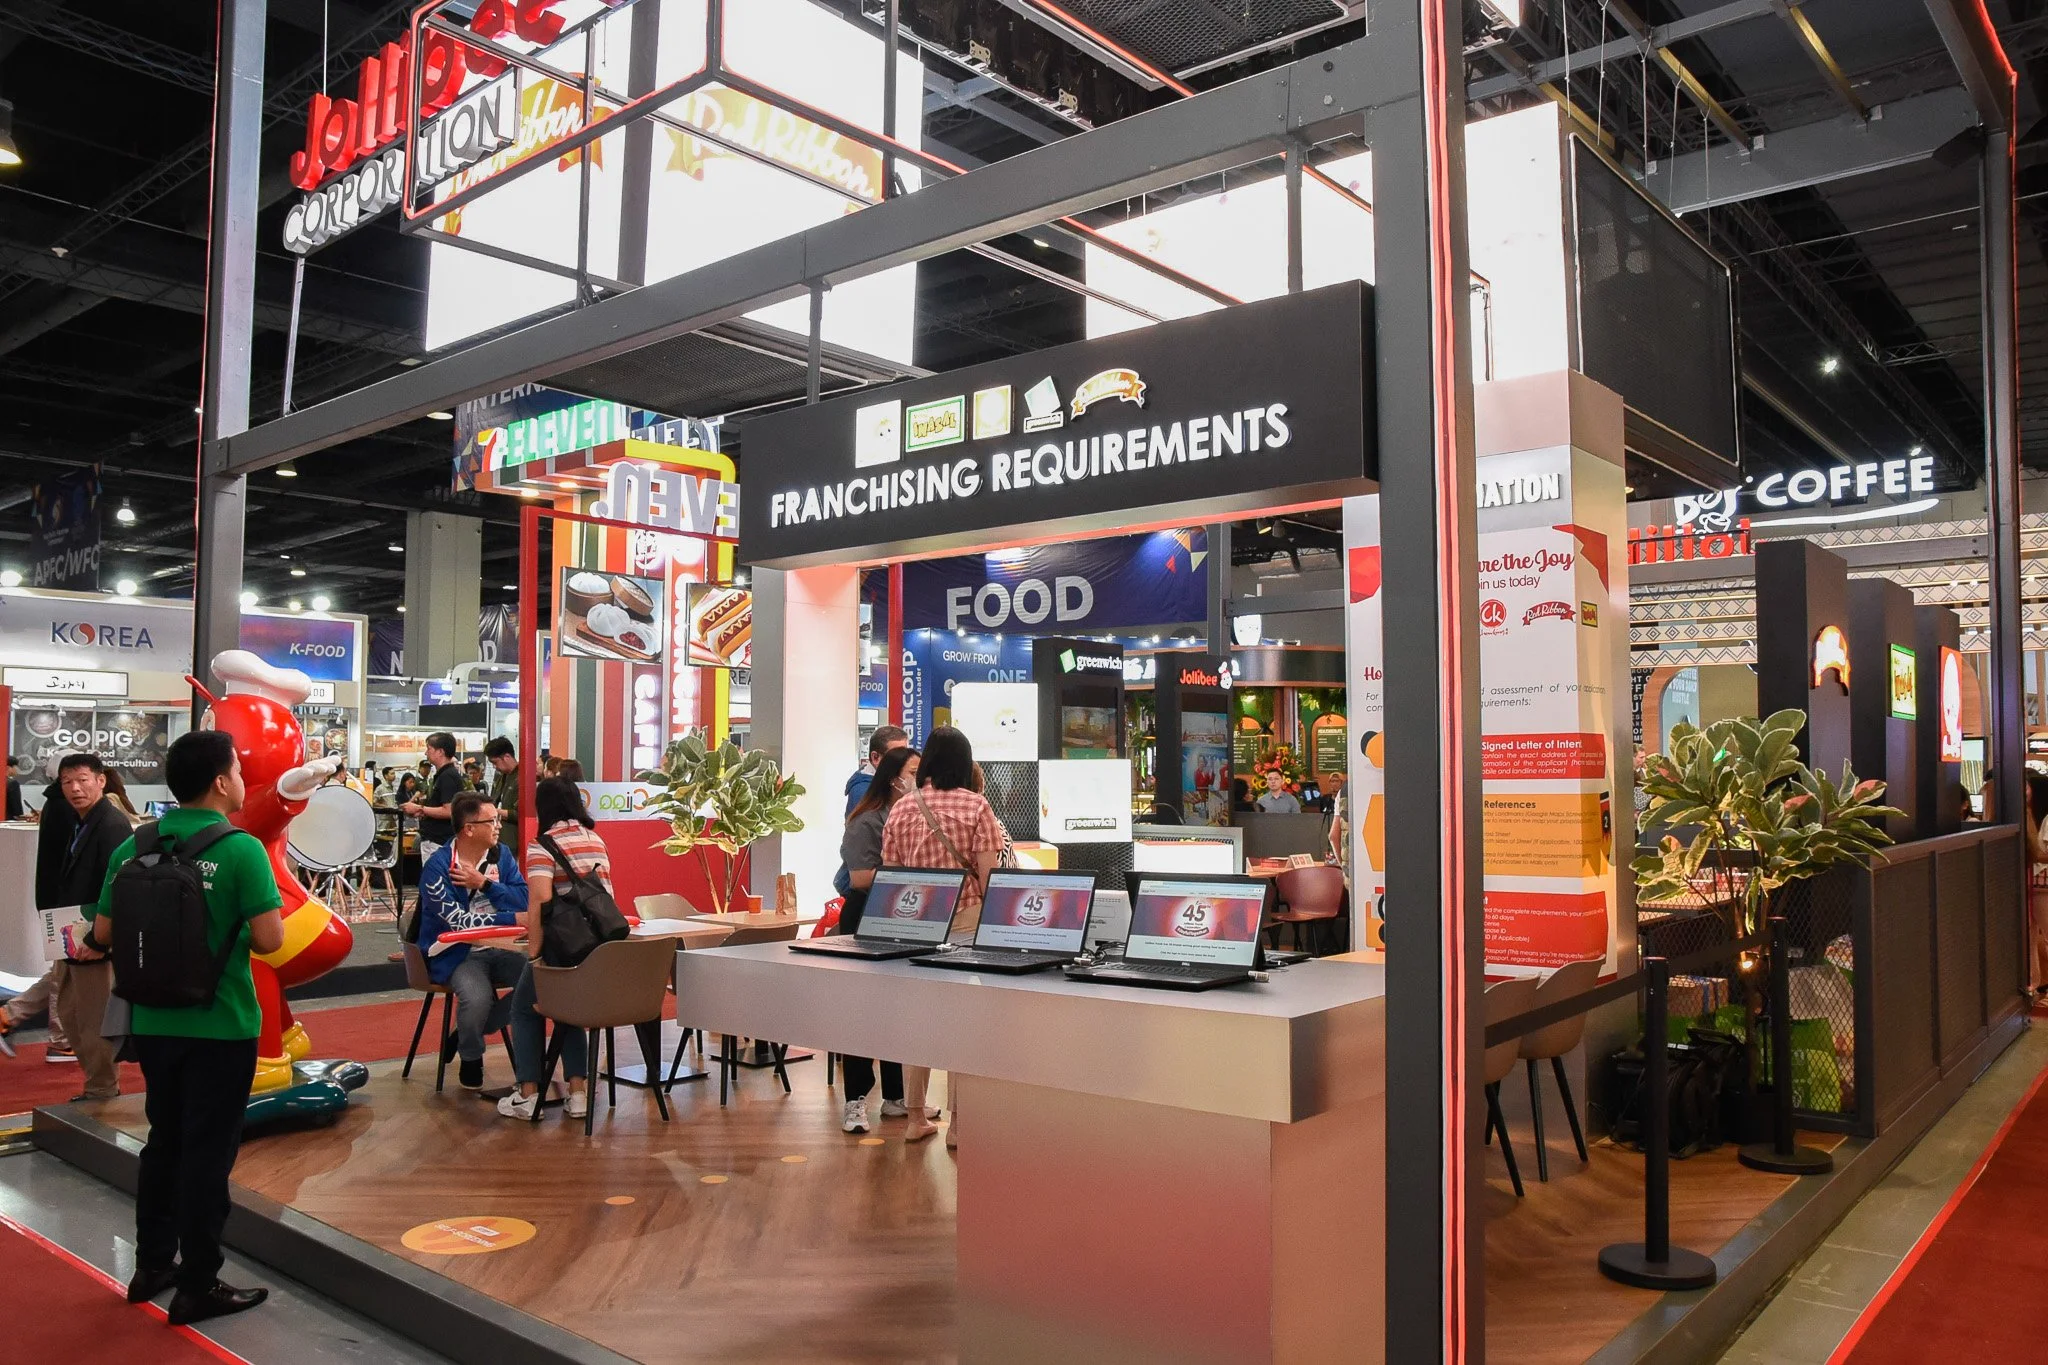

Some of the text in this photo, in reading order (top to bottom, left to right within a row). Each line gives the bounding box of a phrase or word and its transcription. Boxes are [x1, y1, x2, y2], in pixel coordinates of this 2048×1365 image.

[283, 84, 514, 253] CORPORTION
[771, 403, 1290, 528] FRANCHISING REQUIREMENTS
[1502, 553, 1534, 571] the
[1534, 548, 1576, 573] Joy
[1493, 579, 1506, 589] us
[1509, 574, 1541, 589] today
[947, 575, 1094, 630] FOOD
[1541, 602, 1568, 616] Ribbon
[290, 642, 346, 659] K-FOOD
[943, 650, 997, 665] GROW FROM
[1077, 653, 1123, 671] greenwich
[1180, 668, 1218, 686] Jollibee
[1366, 692, 1379, 701] For
[1490, 684, 1543, 696] assessment
[1549, 683, 1560, 693] of
[1481, 741, 1513, 753] Signed
[1516, 741, 1542, 750] Letter
[1545, 740, 1555, 749] of
[1570, 750, 1578, 758] of
[1514, 759, 1520, 767] of
[1523, 759, 1534, 767] the
[1537, 759, 1568, 768] applicant
[1512, 767, 1537, 775] landline
[1538, 767, 1567, 776] number)
[1484, 800, 1537, 810] References
[1066, 818, 1116, 830] greenwich
[902, 890, 919, 906] 45
[1024, 895, 1044, 912] 45
[1183, 904, 1206, 923] 45
[1503, 908, 1530, 916] complete
[1498, 935, 1530, 943] Applicable)
[1510, 956, 1539, 964] regardless
